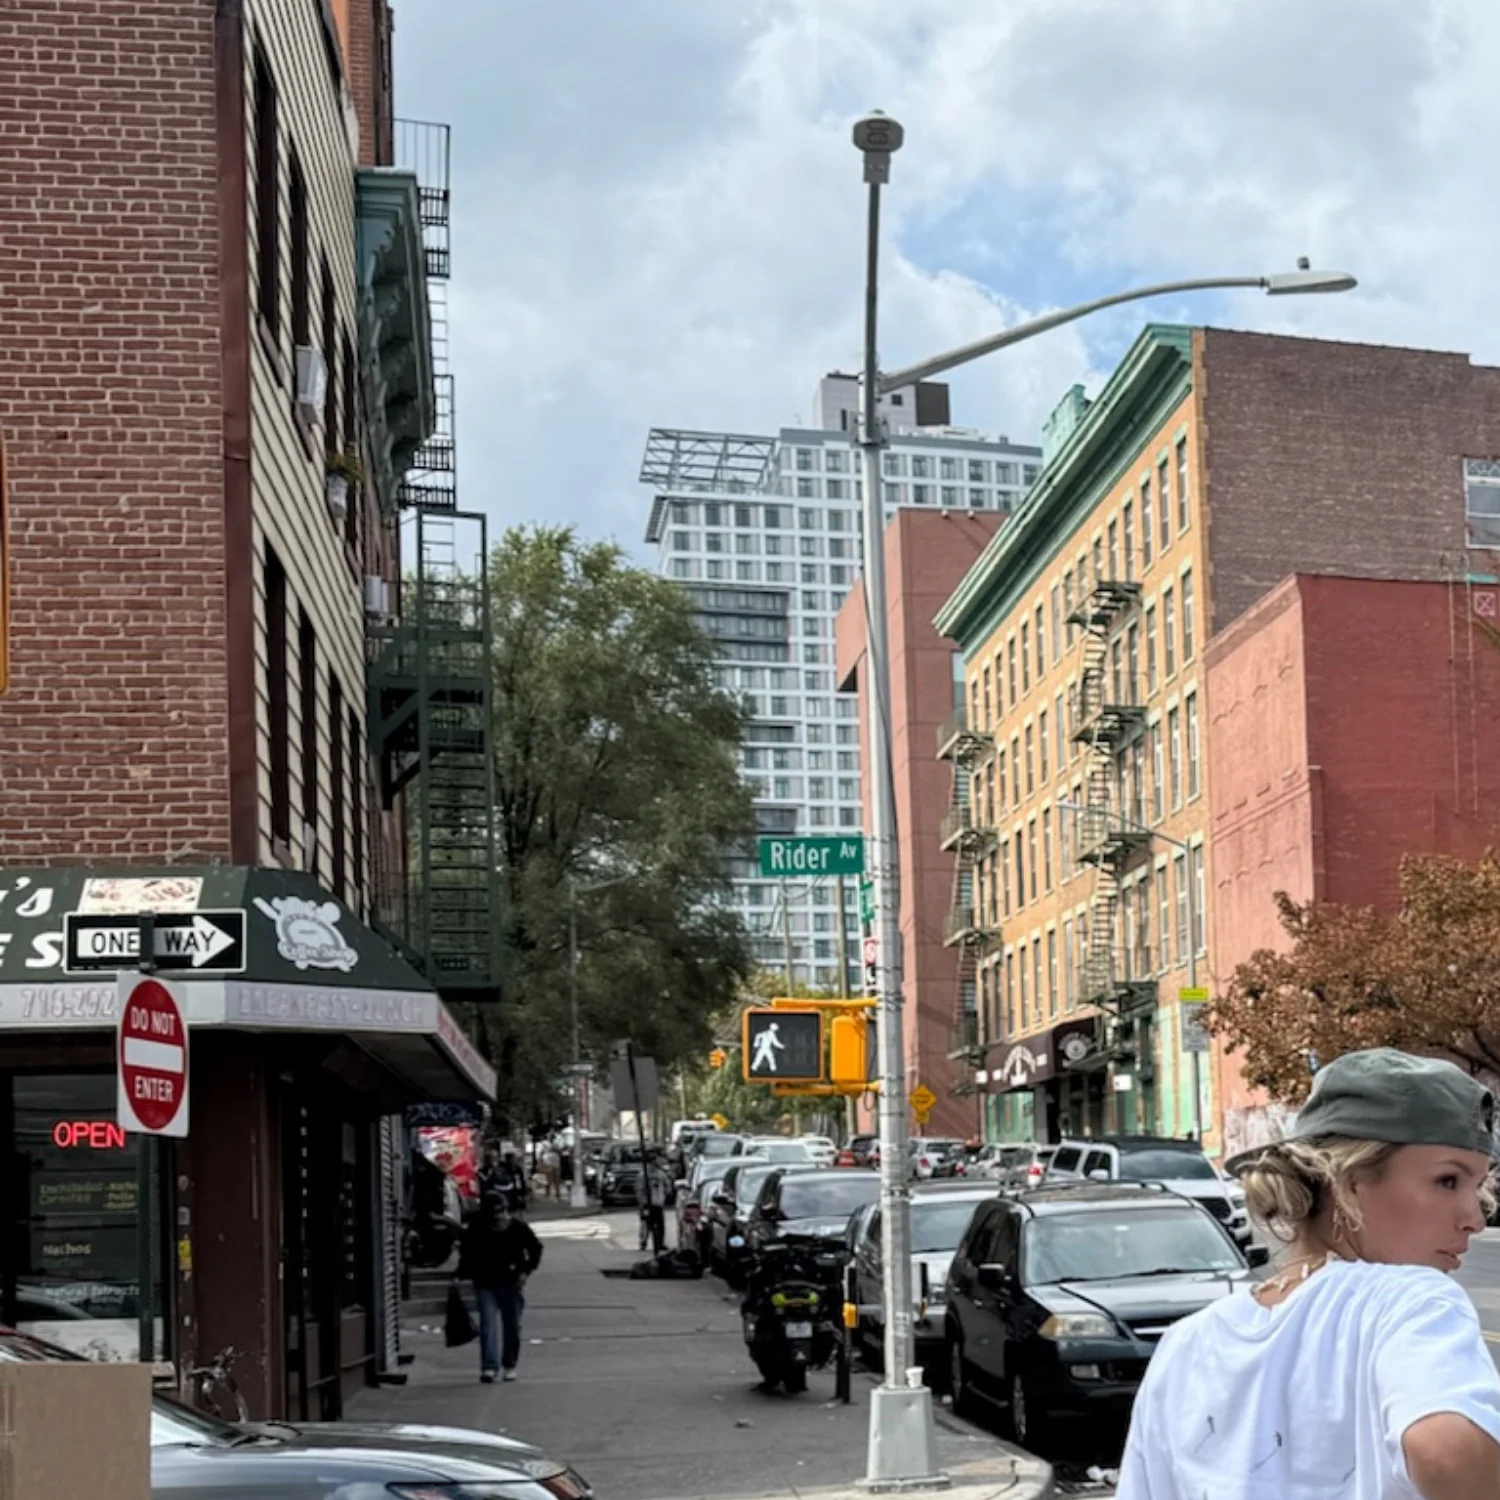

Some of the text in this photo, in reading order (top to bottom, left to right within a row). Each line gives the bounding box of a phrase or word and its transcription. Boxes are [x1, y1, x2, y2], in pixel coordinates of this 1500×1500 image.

[770, 841, 858, 870] Rider Av
[91, 930, 217, 954] ONE WAY
[130, 1006, 176, 1036] DO NOT
[134, 1075, 174, 1103] ENTER
[53, 1121, 127, 1149] OPEN
